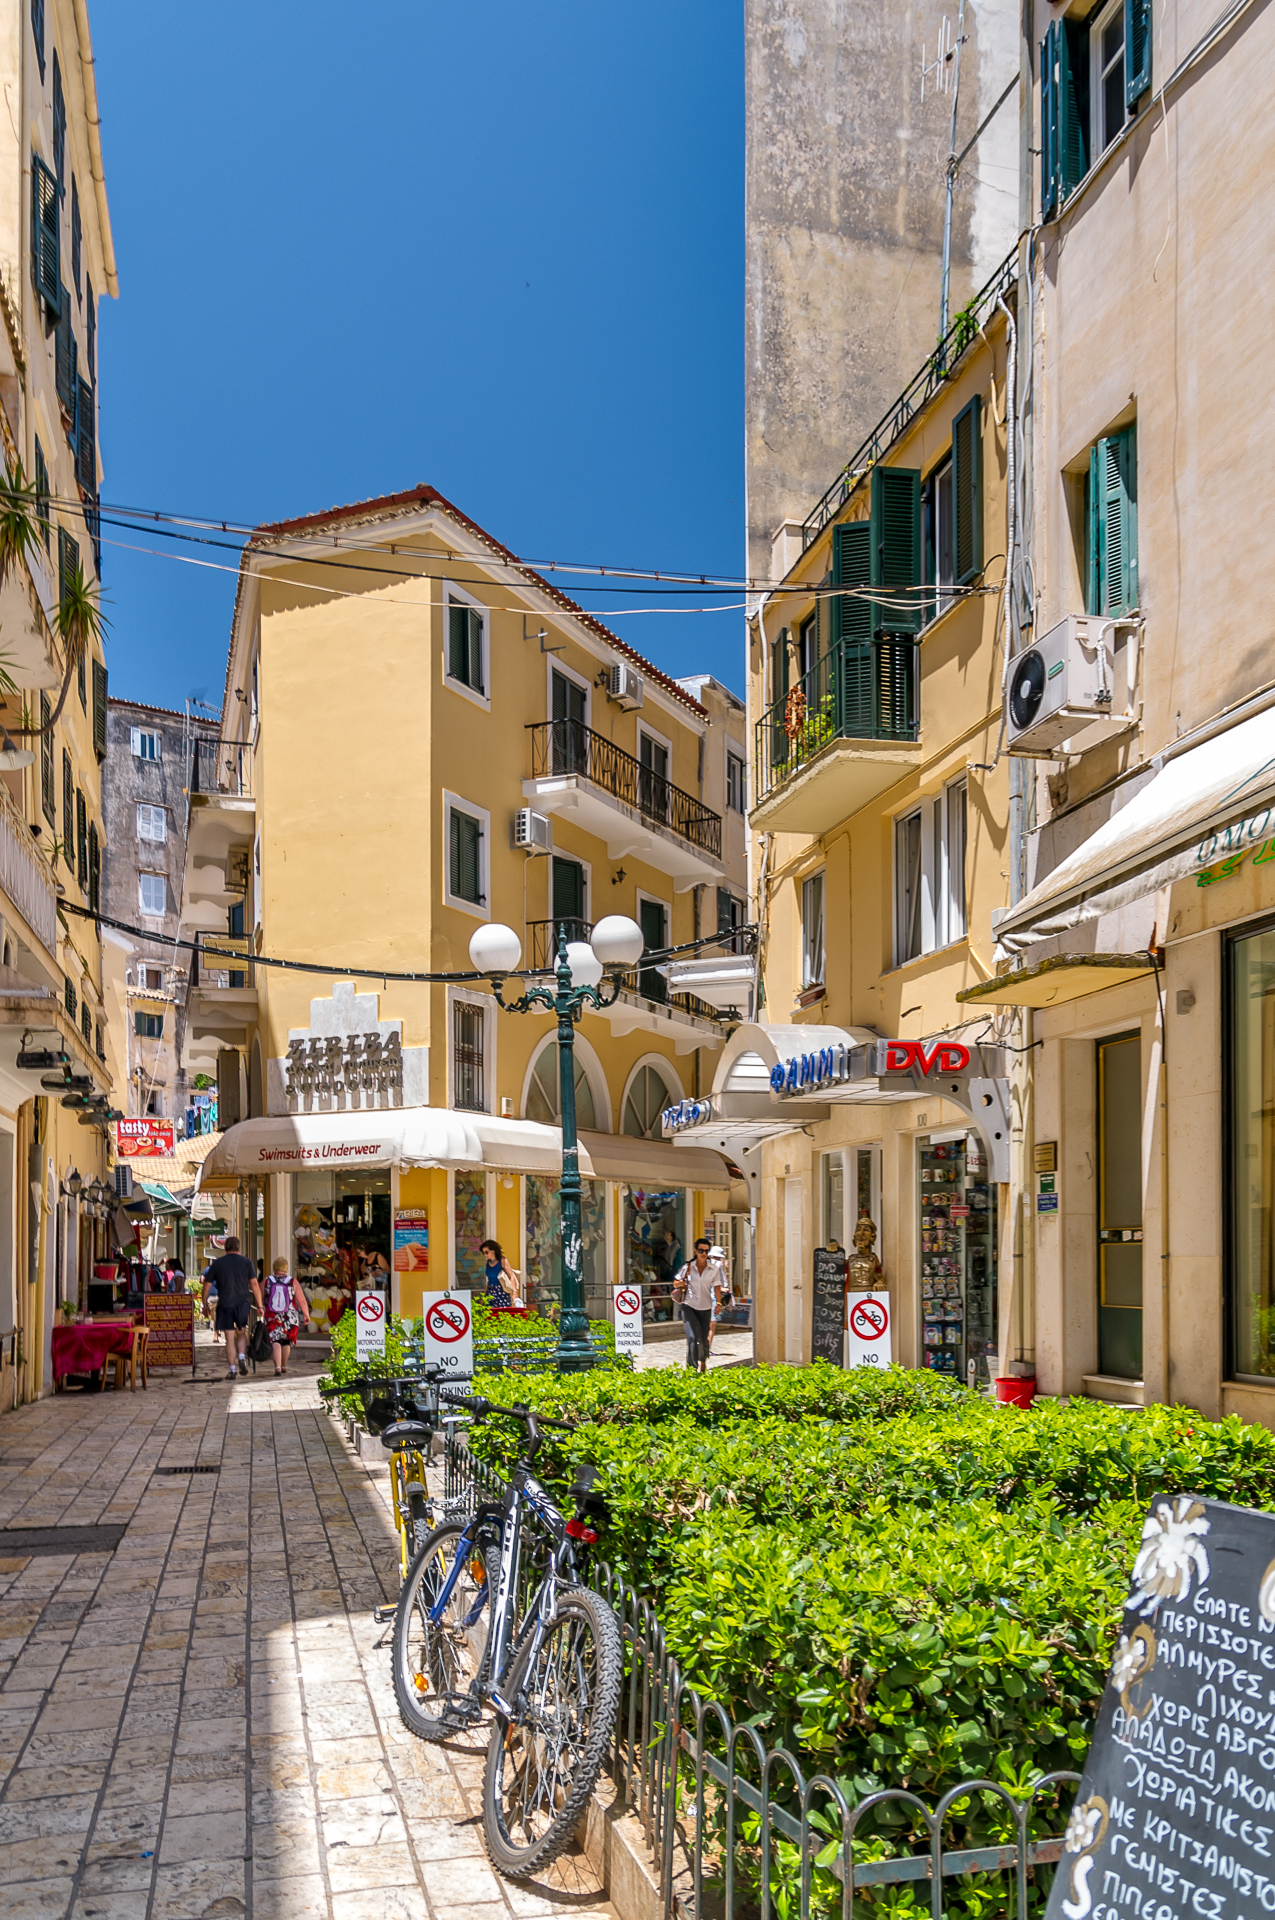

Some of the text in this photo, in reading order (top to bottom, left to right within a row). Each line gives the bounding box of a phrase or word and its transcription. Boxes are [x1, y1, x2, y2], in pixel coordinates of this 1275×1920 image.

[1197, 807, 1275, 863] OMO
[286, 1031, 400, 1060] ZIBIBA
[886, 1041, 970, 1077] DVD
[120, 1119, 150, 1136] tasty
[258, 1143, 382, 1162] Swimsuits & Underwear
[818, 1262, 837, 1274] DVD
[816, 1281, 843, 1295] SALE
[440, 1356, 459, 1367] NO
[862, 1353, 879, 1364] NO
[1109, 1795, 1137, 1829] ΜΕ
